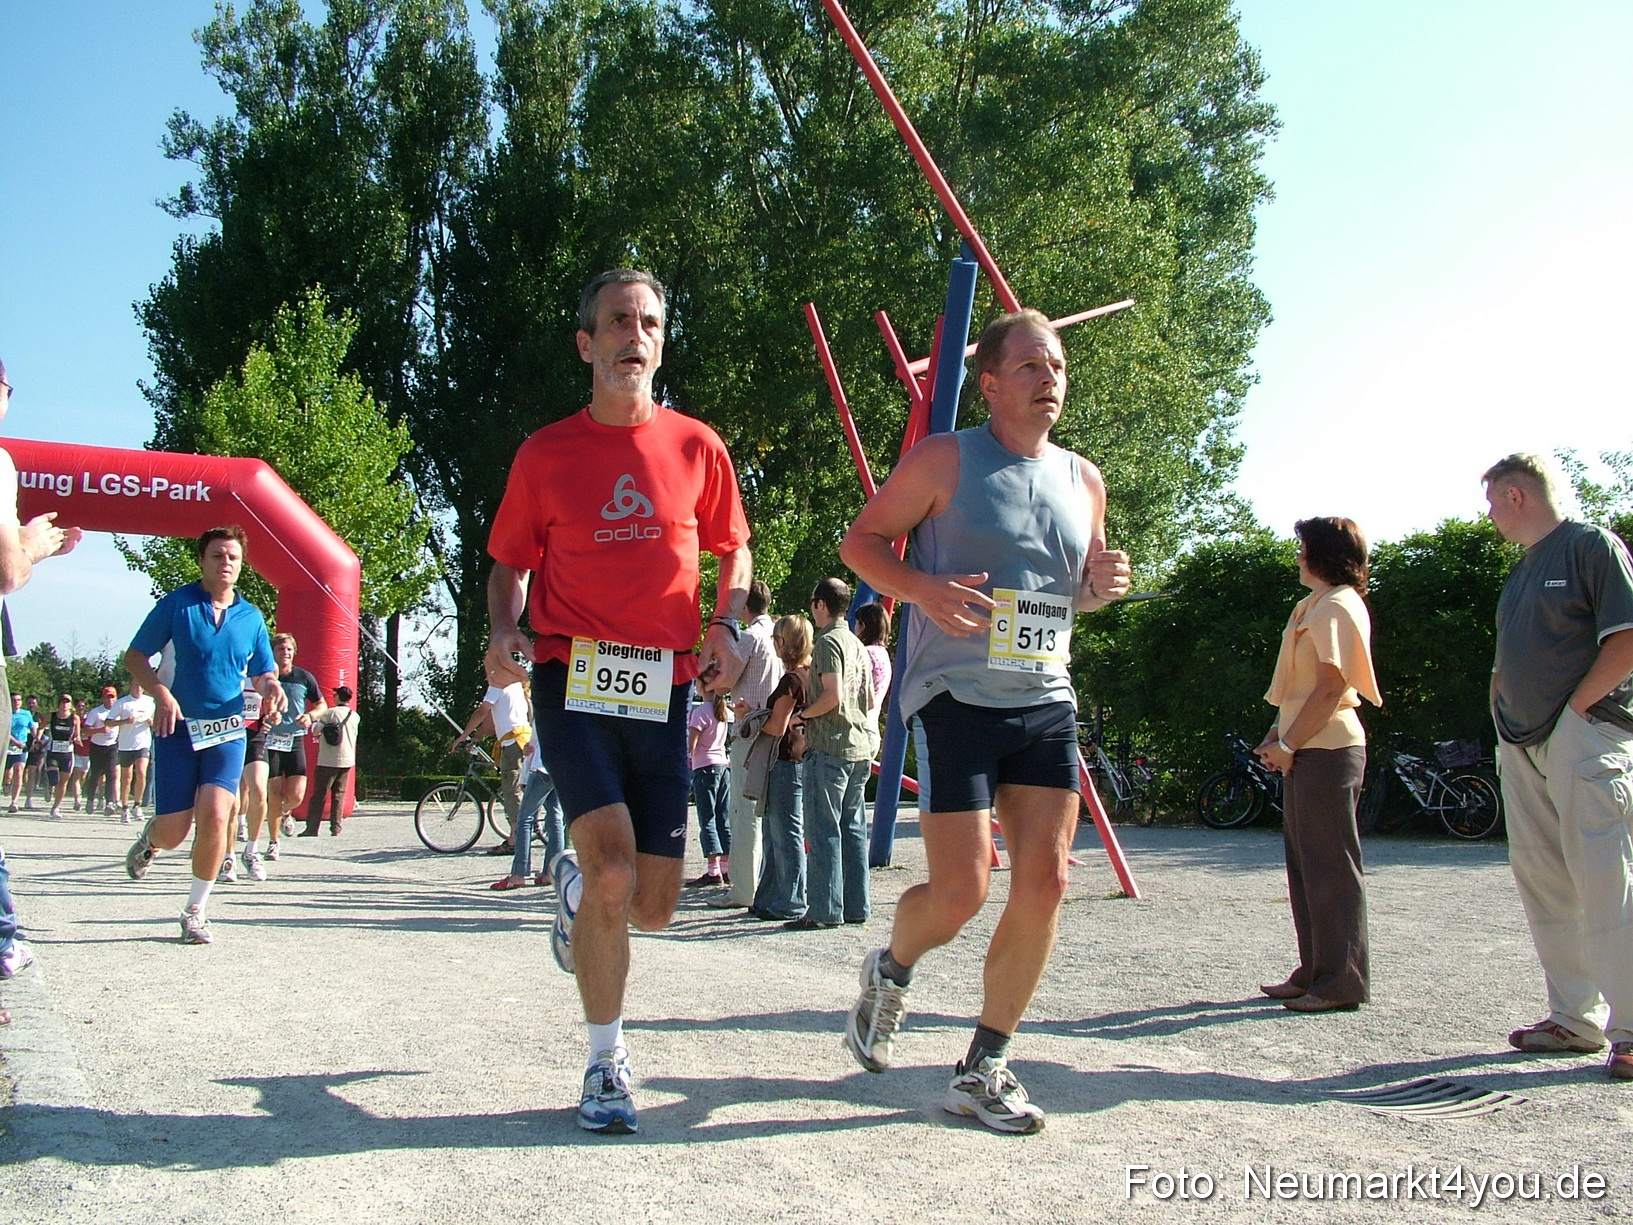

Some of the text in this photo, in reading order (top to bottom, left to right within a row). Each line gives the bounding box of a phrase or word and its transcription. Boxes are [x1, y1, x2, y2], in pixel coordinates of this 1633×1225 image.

[16, 471, 211, 502] ung LGS-Park
[594, 523, 662, 542] odlo
[1017, 600, 1068, 620] Wolfgang
[997, 620, 1008, 632] C
[1017, 626, 1056, 652] 513
[598, 641, 662, 662] Siegfried
[575, 659, 587, 673] B
[596, 667, 648, 696] 956
[629, 705, 667, 717] PFLEIDERER
[203, 717, 240, 736] 2070
